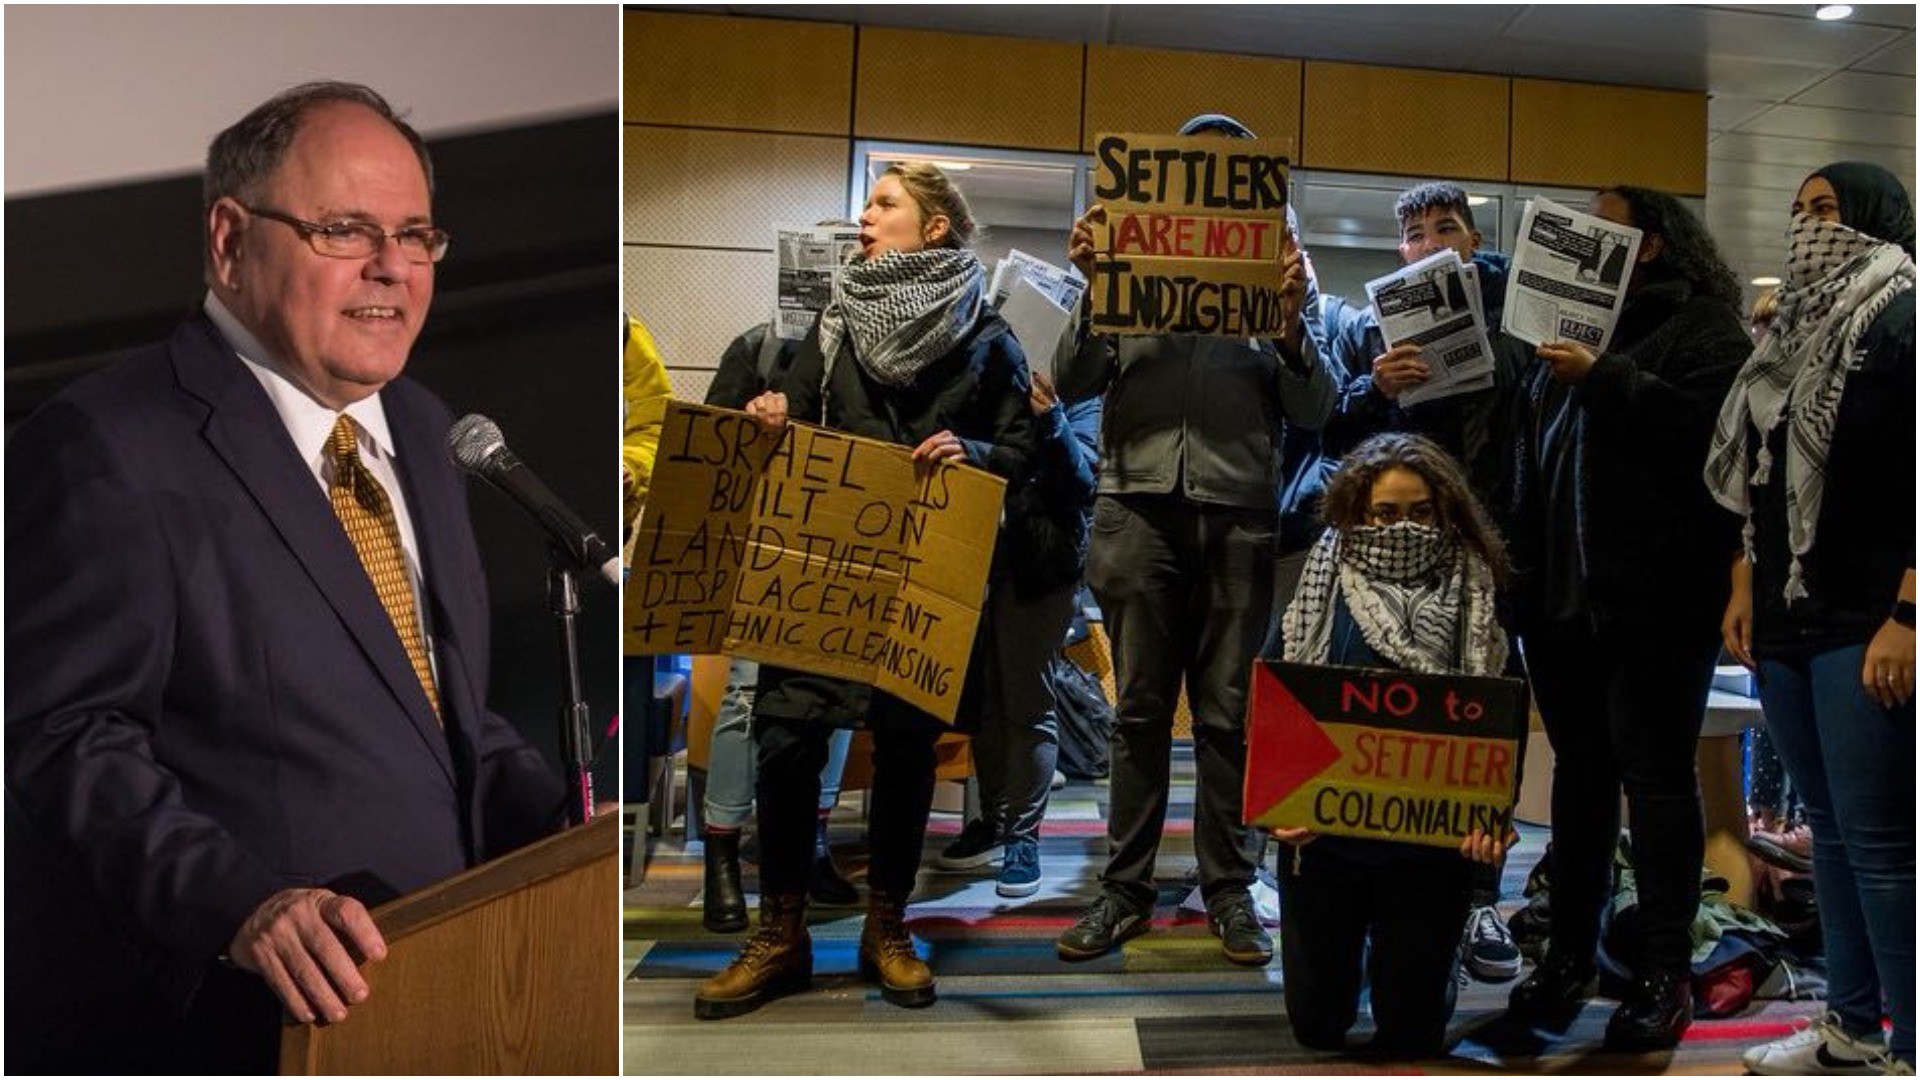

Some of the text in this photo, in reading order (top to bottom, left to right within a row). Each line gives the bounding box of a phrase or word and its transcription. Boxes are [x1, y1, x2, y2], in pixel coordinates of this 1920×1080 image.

[1095, 136, 1289, 210] SETTLERS
[1116, 213, 1269, 260] ARE NOT
[669, 408, 959, 511] ISRAEL IS
[709, 469, 926, 546] BUILT ON
[650, 514, 922, 590] LAND THEFT
[643, 569, 942, 641] DISPLACEMENT
[675, 609, 804, 646] ETHNIC
[819, 626, 953, 697] CLEANSING
[1341, 680, 1484, 722] NO to
[1351, 731, 1511, 789] SETTLER
[1314, 786, 1513, 842] COLONIALISM
